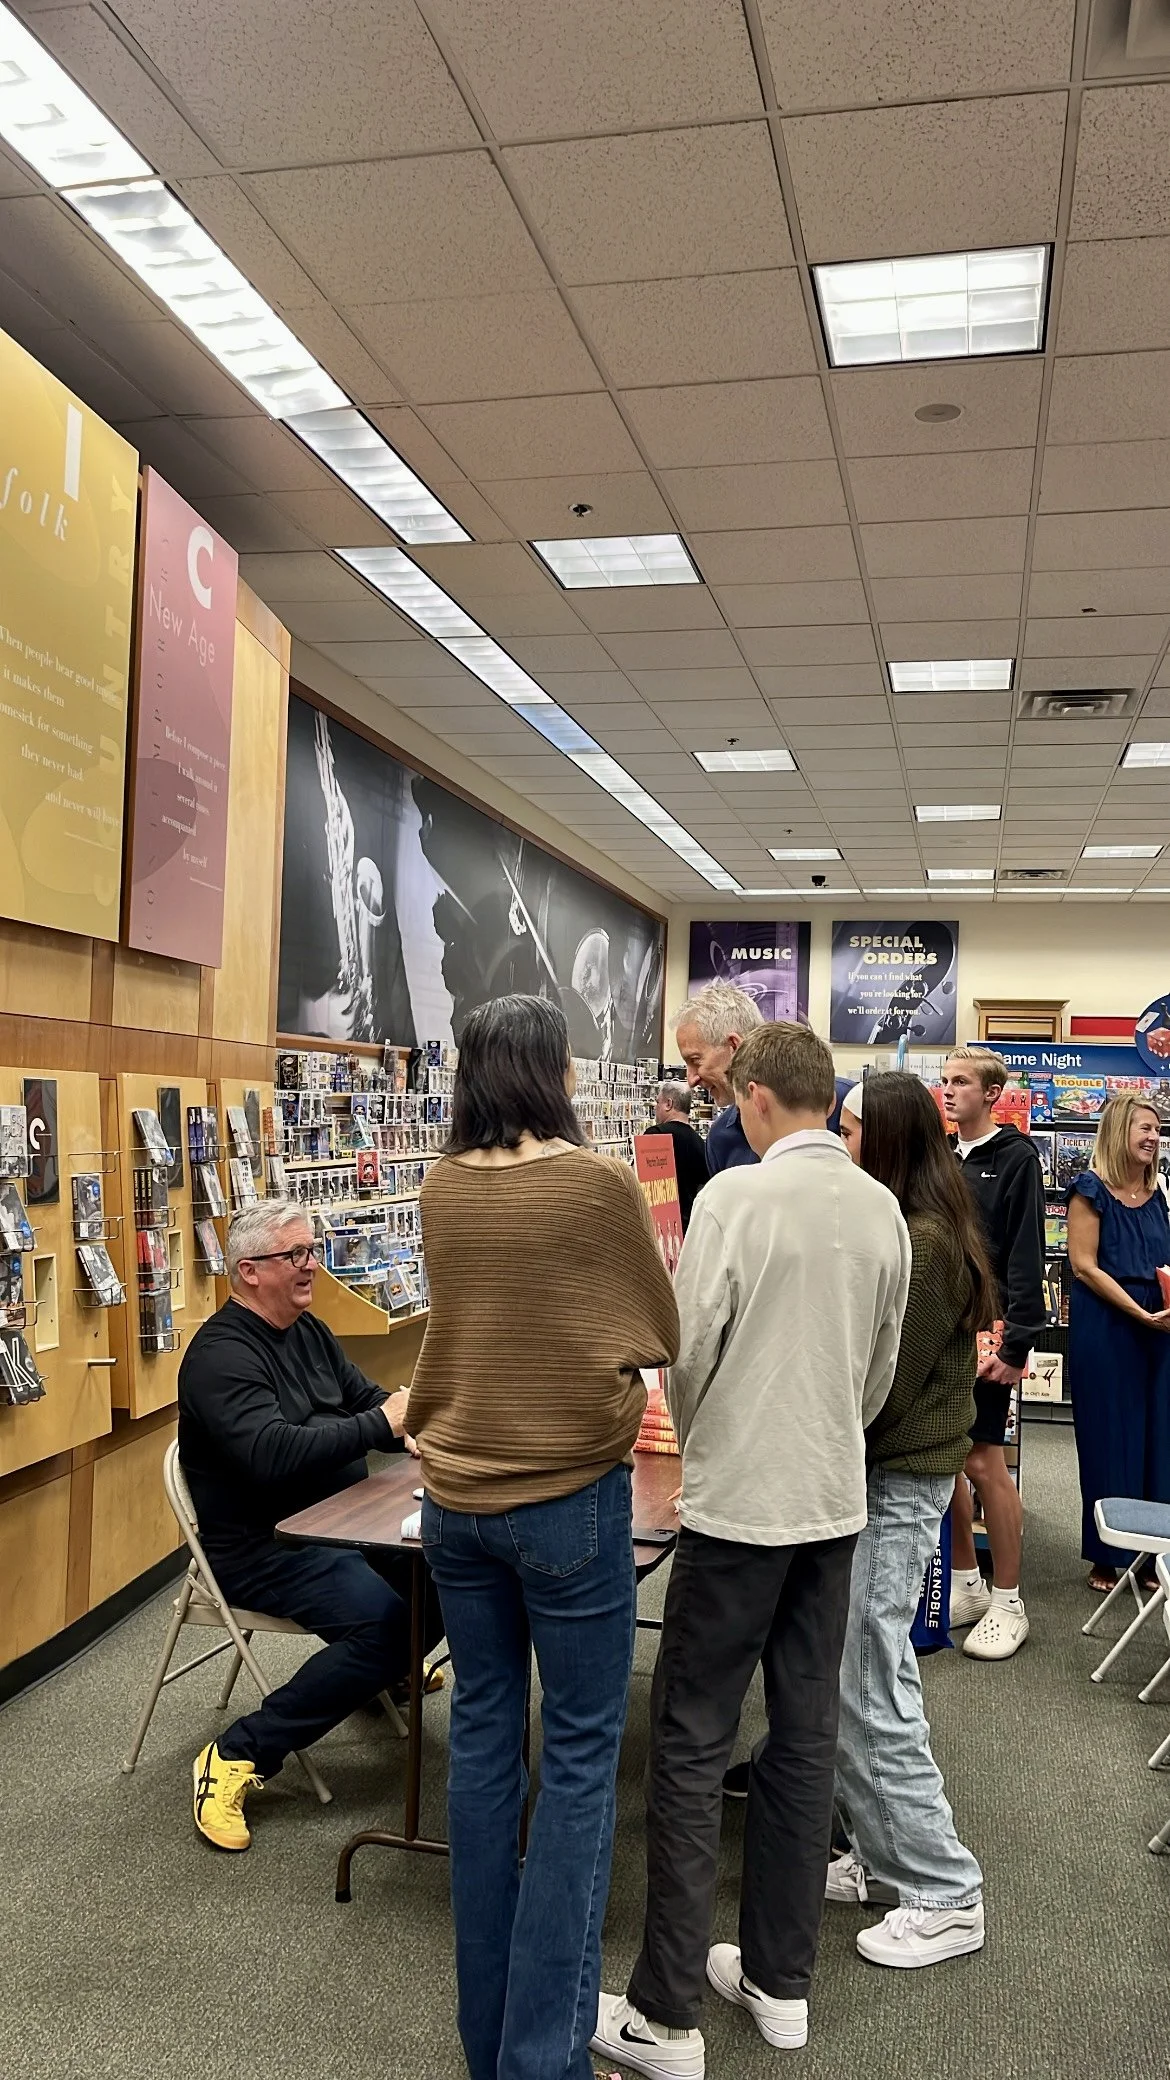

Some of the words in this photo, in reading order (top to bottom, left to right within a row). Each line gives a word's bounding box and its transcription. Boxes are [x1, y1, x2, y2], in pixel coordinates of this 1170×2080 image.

[0, 467, 68, 541] folk
[187, 525, 214, 610] C
[150, 583, 183, 637] New
[188, 620, 215, 667] Age
[25, 645, 54, 668] people
[56, 656, 74, 679] hear
[74, 674, 95, 691] good
[3, 665, 10, 681] it
[13, 673, 41, 696] makes
[43, 685, 65, 708] them
[0, 702, 35, 727] omesick
[38, 715, 50, 733] for
[52, 727, 93, 757] something
[21, 743, 39, 766] they
[42, 756, 65, 773] never
[45, 791, 61, 806] and
[63, 798, 87, 815] never
[849, 935, 923, 948] SPECIAL
[731, 948, 792, 960] MUSIC
[863, 952, 938, 965] ORDERS
[855, 974, 869, 983] you
[869, 972, 887, 981] can't
[889, 972, 904, 981] find
[905, 971, 923, 981] what
[860, 989, 883, 1000] you're
[883, 990, 911, 1000] looking
[847, 1006, 864, 1015] we'll
[865, 1006, 885, 1015] order
[893, 1006, 906, 1016] for
[995, 1052, 1036, 1066] ame
[1041, 1053, 1082, 1069] Night
[1055, 1078, 1103, 1088] TROUBLE
